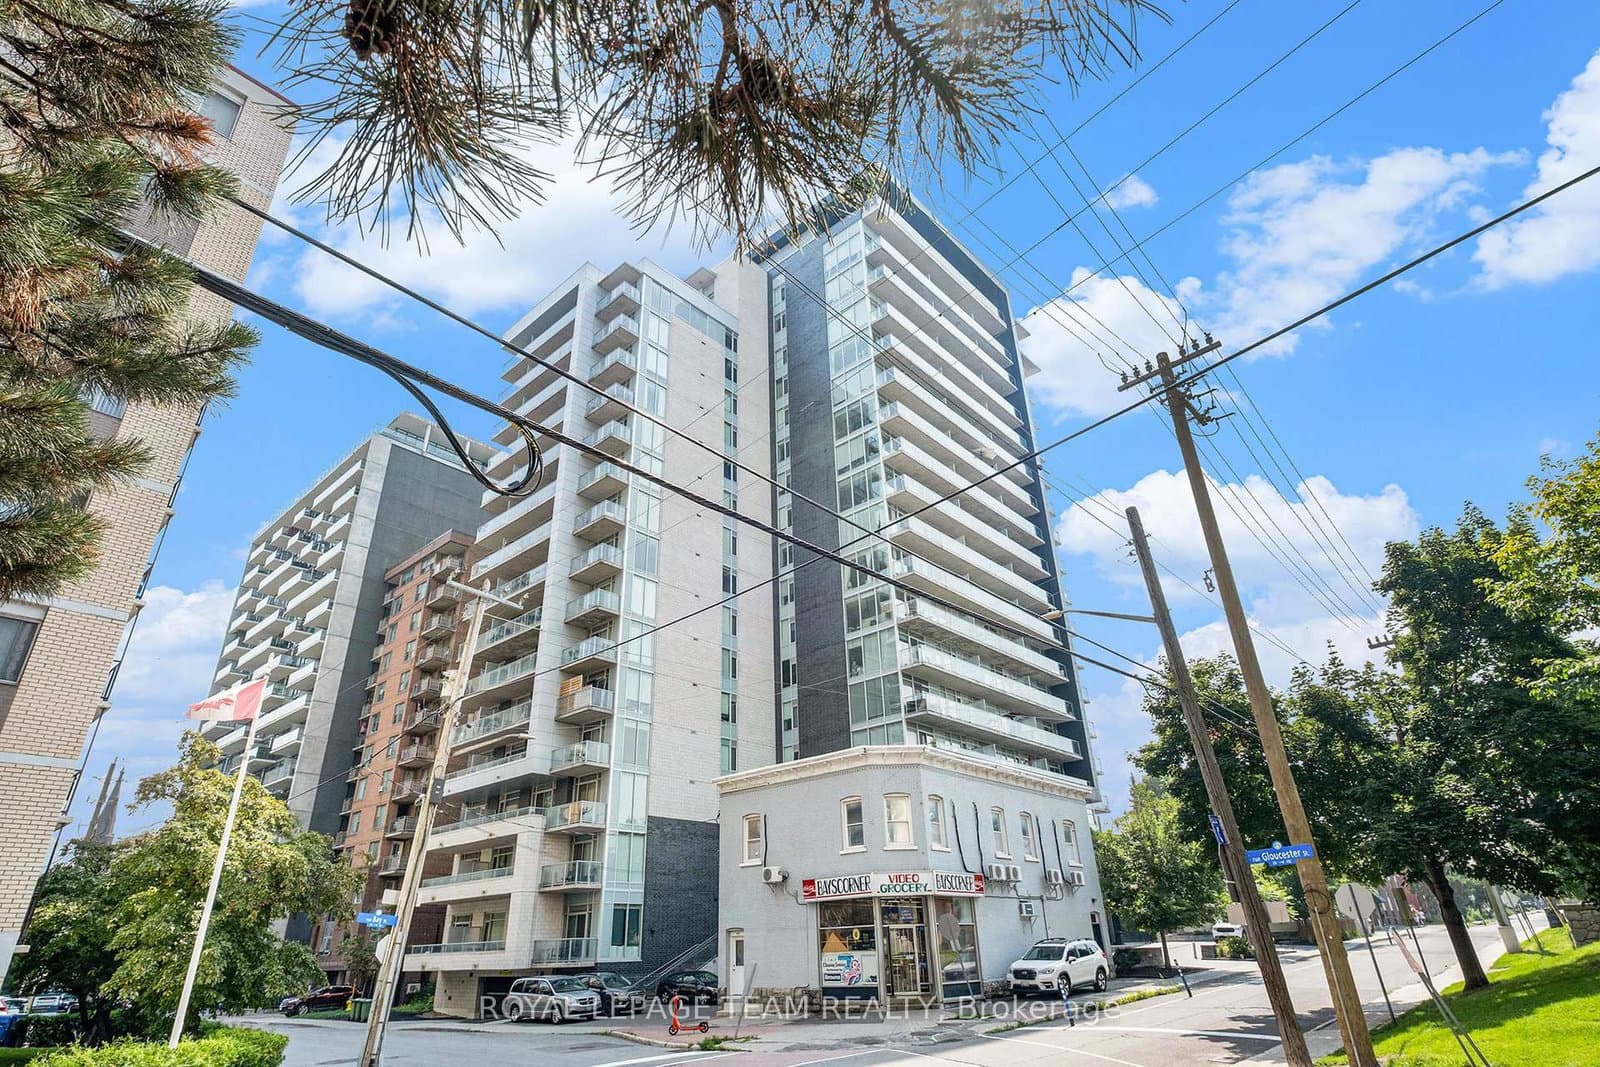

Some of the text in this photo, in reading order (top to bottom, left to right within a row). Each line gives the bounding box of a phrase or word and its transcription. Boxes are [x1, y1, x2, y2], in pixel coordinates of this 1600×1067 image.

[1261, 850, 1300, 861] Gloucester
[888, 873, 920, 883] VIDEO
[880, 883, 928, 893] GROCERY
